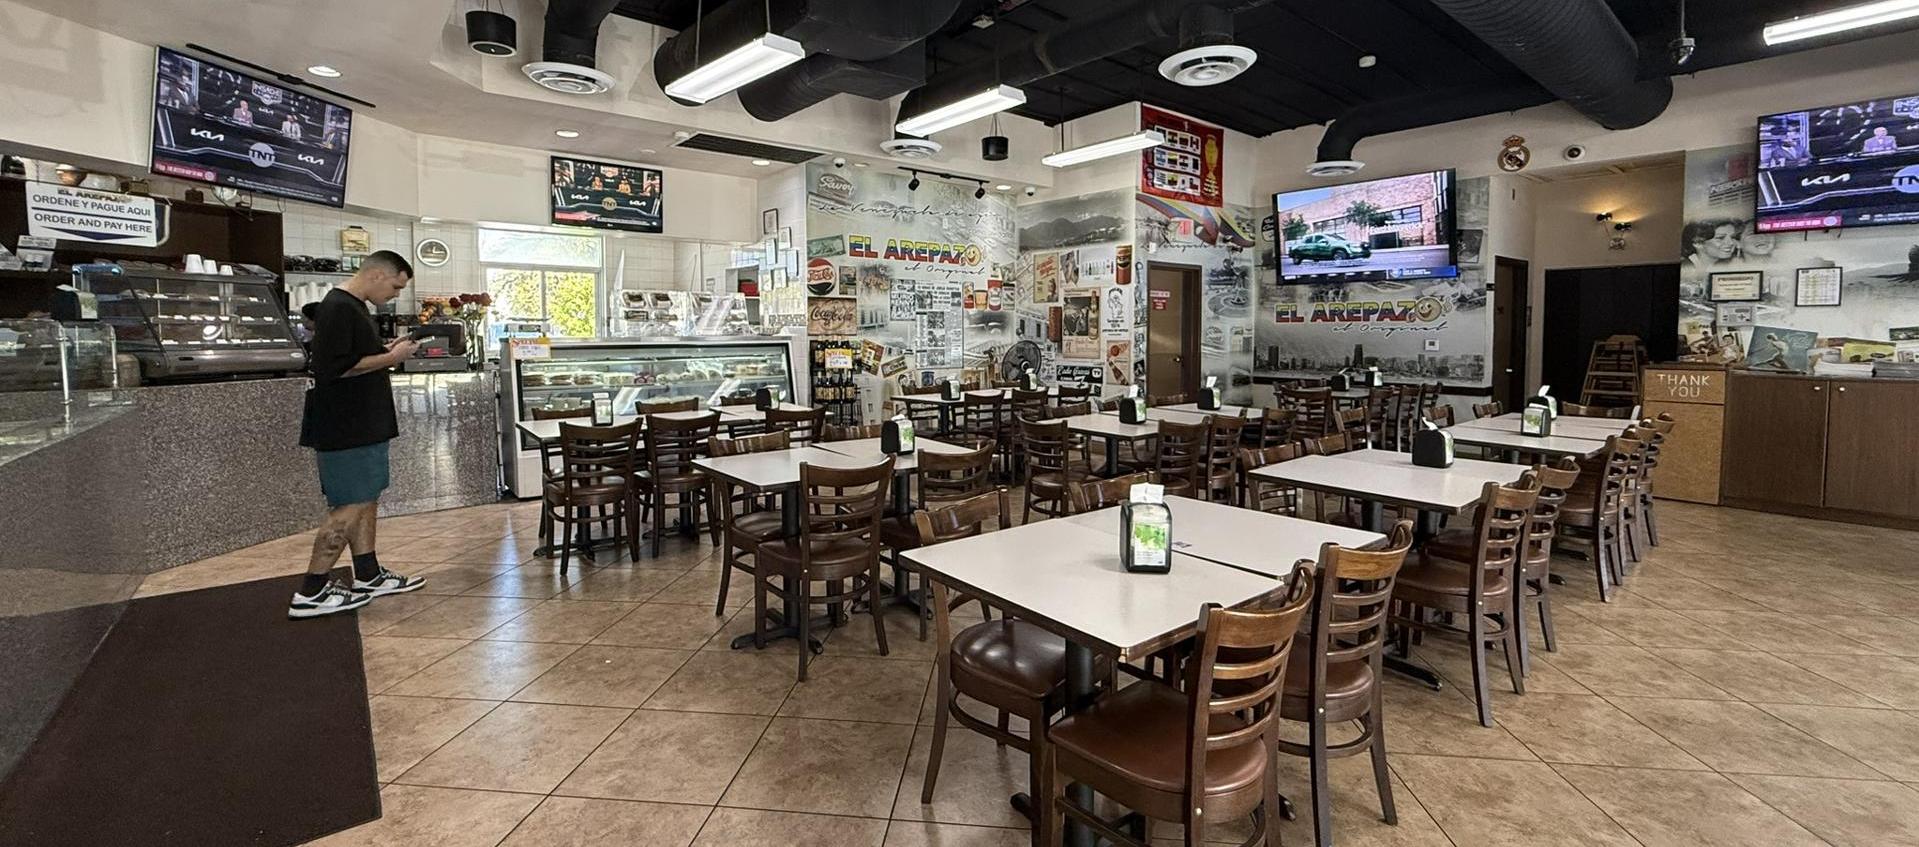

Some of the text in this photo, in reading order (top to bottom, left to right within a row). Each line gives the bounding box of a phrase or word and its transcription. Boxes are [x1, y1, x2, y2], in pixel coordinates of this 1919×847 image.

[190, 128, 225, 142] KIA
[250, 149, 275, 162] TNT
[297, 154, 325, 166] KIA
[819, 176, 854, 195] Savoy
[1801, 173, 1851, 187] KIA
[32, 194, 151, 216] ORDENE Y PAGUE AQUI
[34, 213, 152, 234] ORDER AND PAY HERE
[848, 234, 983, 267] EL AREPAZO
[926, 263, 986, 279] Original
[1275, 297, 1443, 323] EL AREPAZO
[1359, 321, 1449, 339] Original
[1656, 373, 1710, 386] THANK
[1668, 386, 1700, 398] YOU
